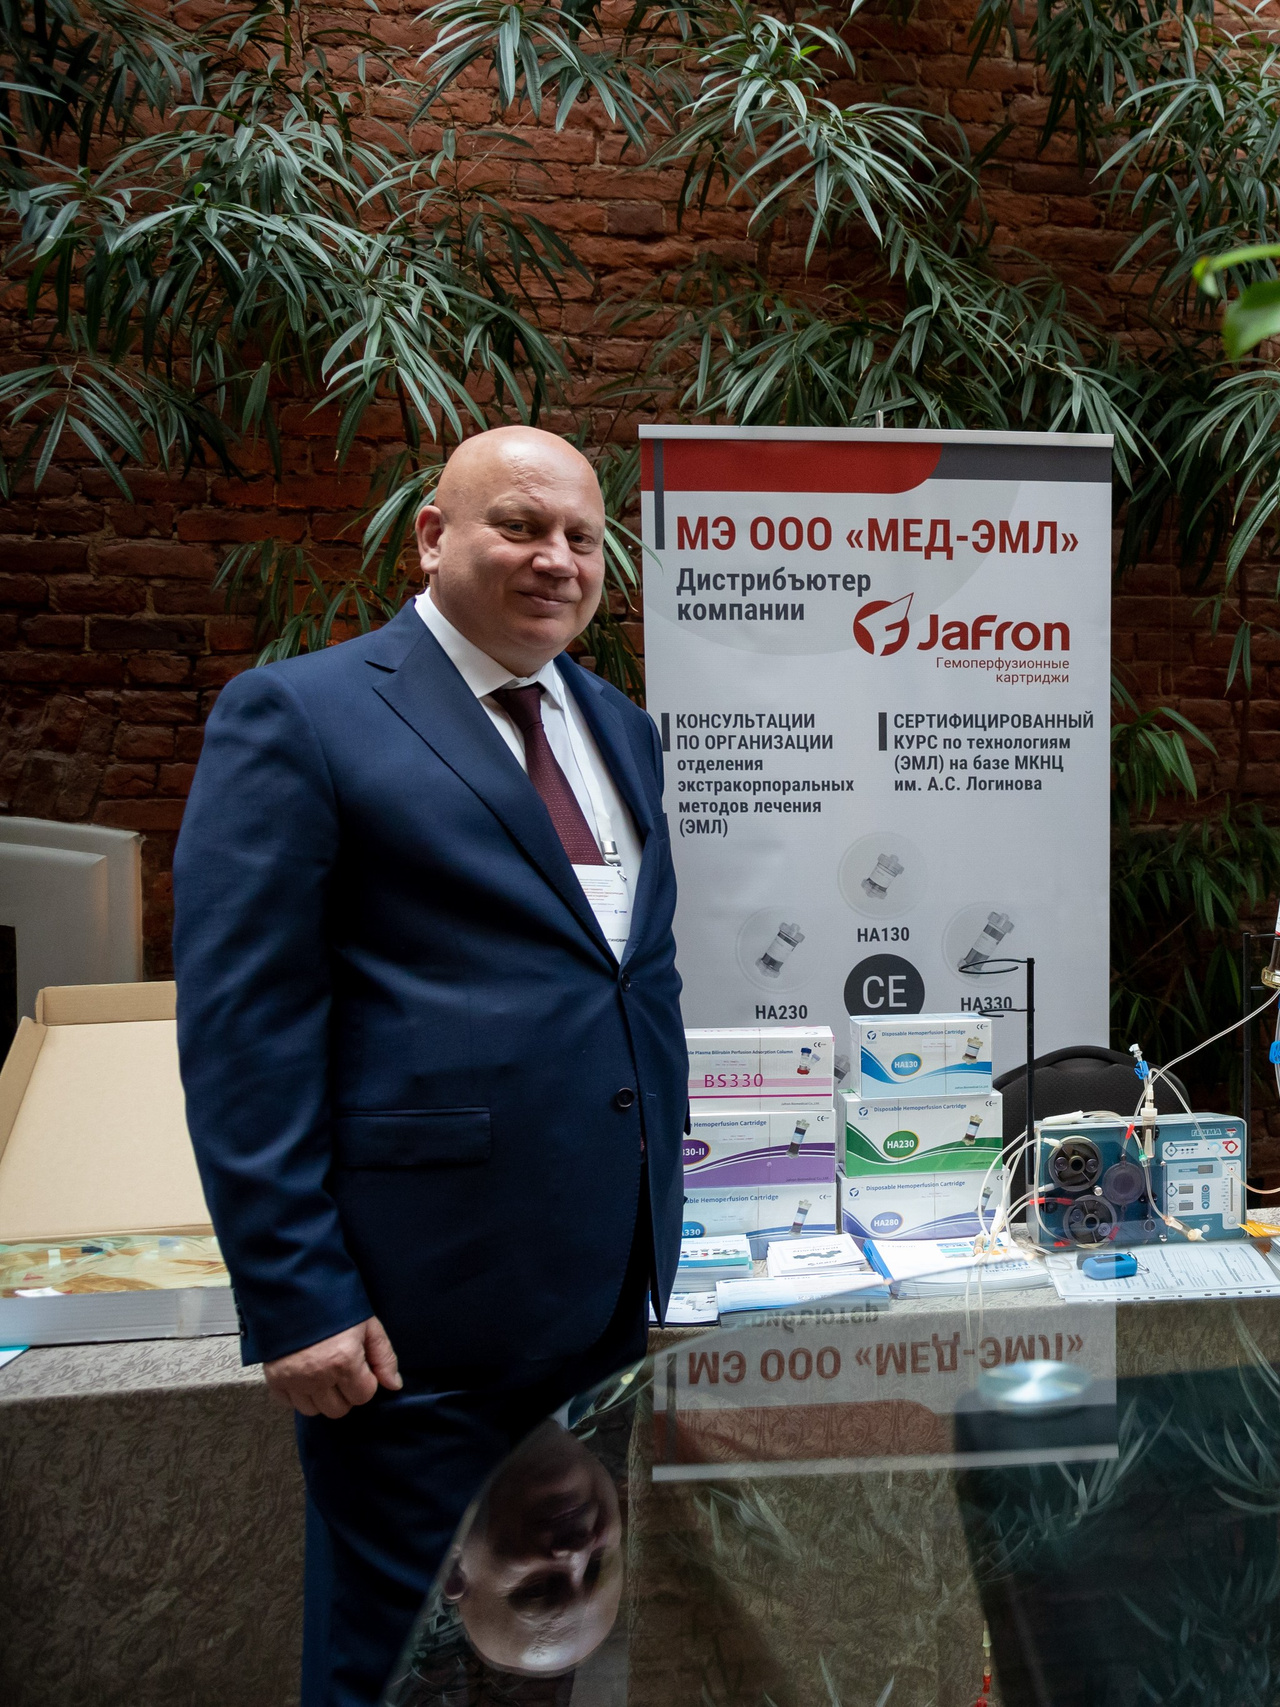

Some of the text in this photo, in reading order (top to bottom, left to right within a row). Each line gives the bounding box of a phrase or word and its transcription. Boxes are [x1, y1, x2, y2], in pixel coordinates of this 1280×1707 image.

[676, 516, 1080, 561] МЭ ООО «МЕД-ЭМЛ»
[676, 567, 872, 598] Дистрибъютер
[677, 602, 806, 622] компании
[935, 656, 1070, 672] Гемоперфузионные
[995, 671, 1070, 686] картриджи
[676, 713, 816, 732] КОНСУЛЬТАЦИИ
[893, 710, 1094, 732] СЕРТИФИЦИРОВАННЫЙ
[676, 734, 834, 753] ПО ОРГАНИЗАЦИИ
[893, 734, 1071, 750] КУРС по технологиям
[677, 759, 764, 774] отделения
[894, 754, 1064, 774] (ЭМЛ) на базе МКНЦ
[677, 779, 855, 796] экстракорпоральных
[894, 776, 1042, 792] им. А.С. Логинова
[678, 801, 822, 816] методов лечения
[679, 818, 728, 838] (ЭМЛ)
[857, 926, 910, 943] HA130
[755, 1004, 808, 1020] HA230
[960, 996, 1014, 1012] HA330
[894, 1061, 919, 1069] HA130
[704, 1073, 764, 1088] BS330
[873, 1105, 902, 1113] Disposable
[902, 1104, 943, 1112] Hemoperfusion
[693, 1119, 767, 1129] Hemoperfusion Cartridge
[886, 1140, 915, 1149] HA230
[866, 1181, 966, 1192] Disposable Hemoperfusion Cartridge
[700, 1195, 749, 1204] Hemoperfusion
[749, 1194, 779, 1202] Cartridge
[873, 1219, 899, 1227] HA280
